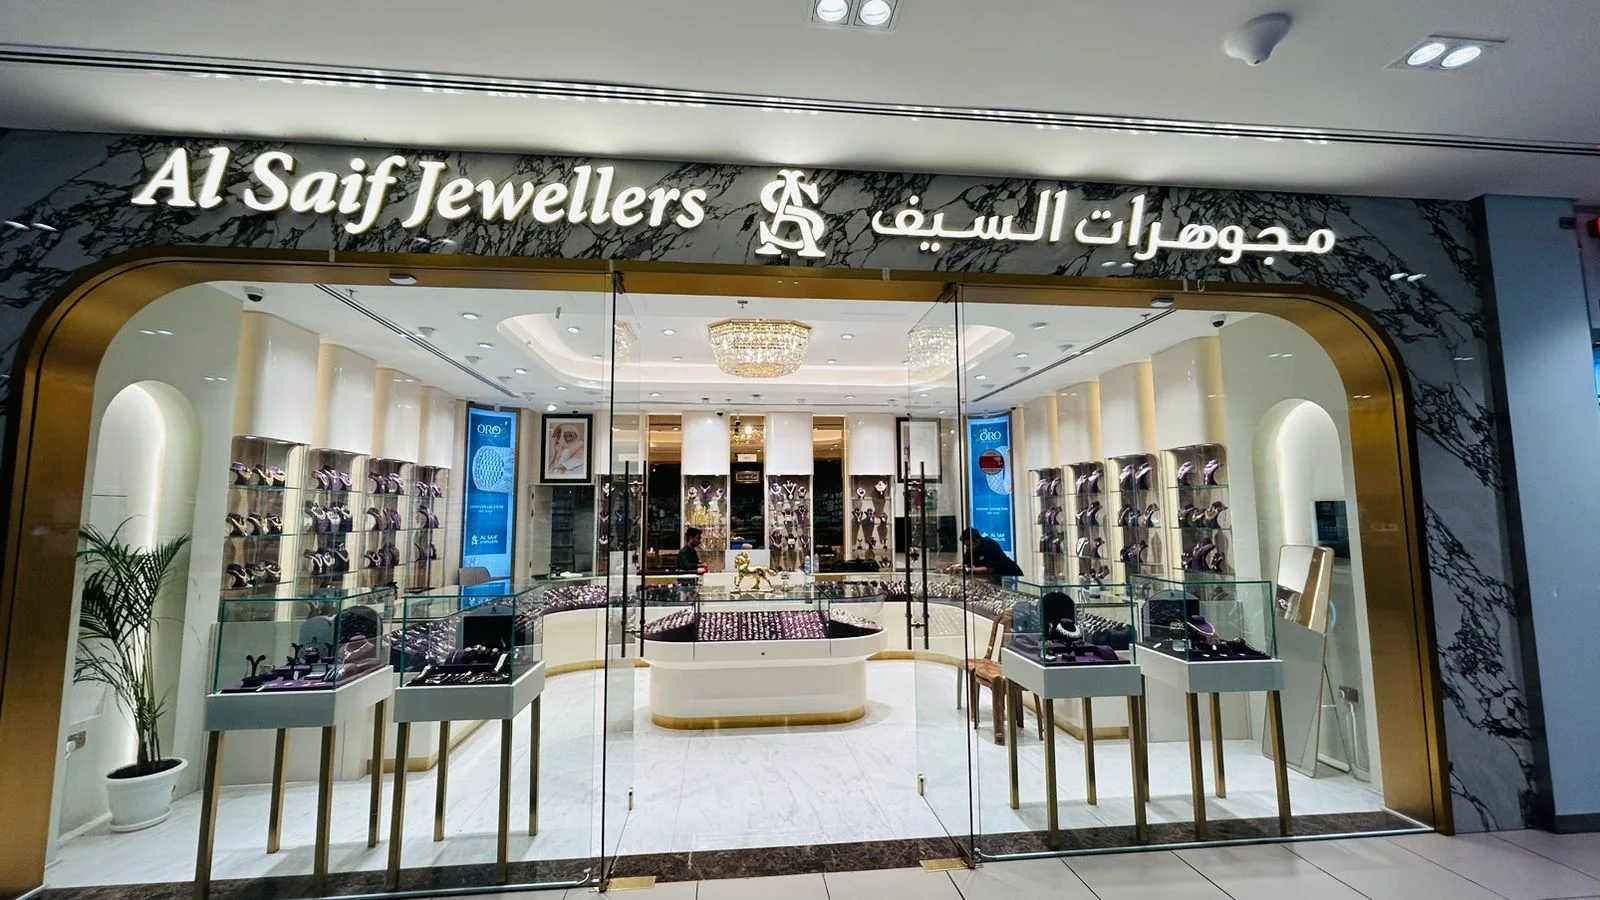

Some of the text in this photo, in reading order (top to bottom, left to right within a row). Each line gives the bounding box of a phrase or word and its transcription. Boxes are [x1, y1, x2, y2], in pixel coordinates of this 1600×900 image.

[131, 147, 707, 235] Al Saif Jewellers
[872, 189, 1336, 265] مجوهرات السيف
[477, 424, 501, 435] ORO
